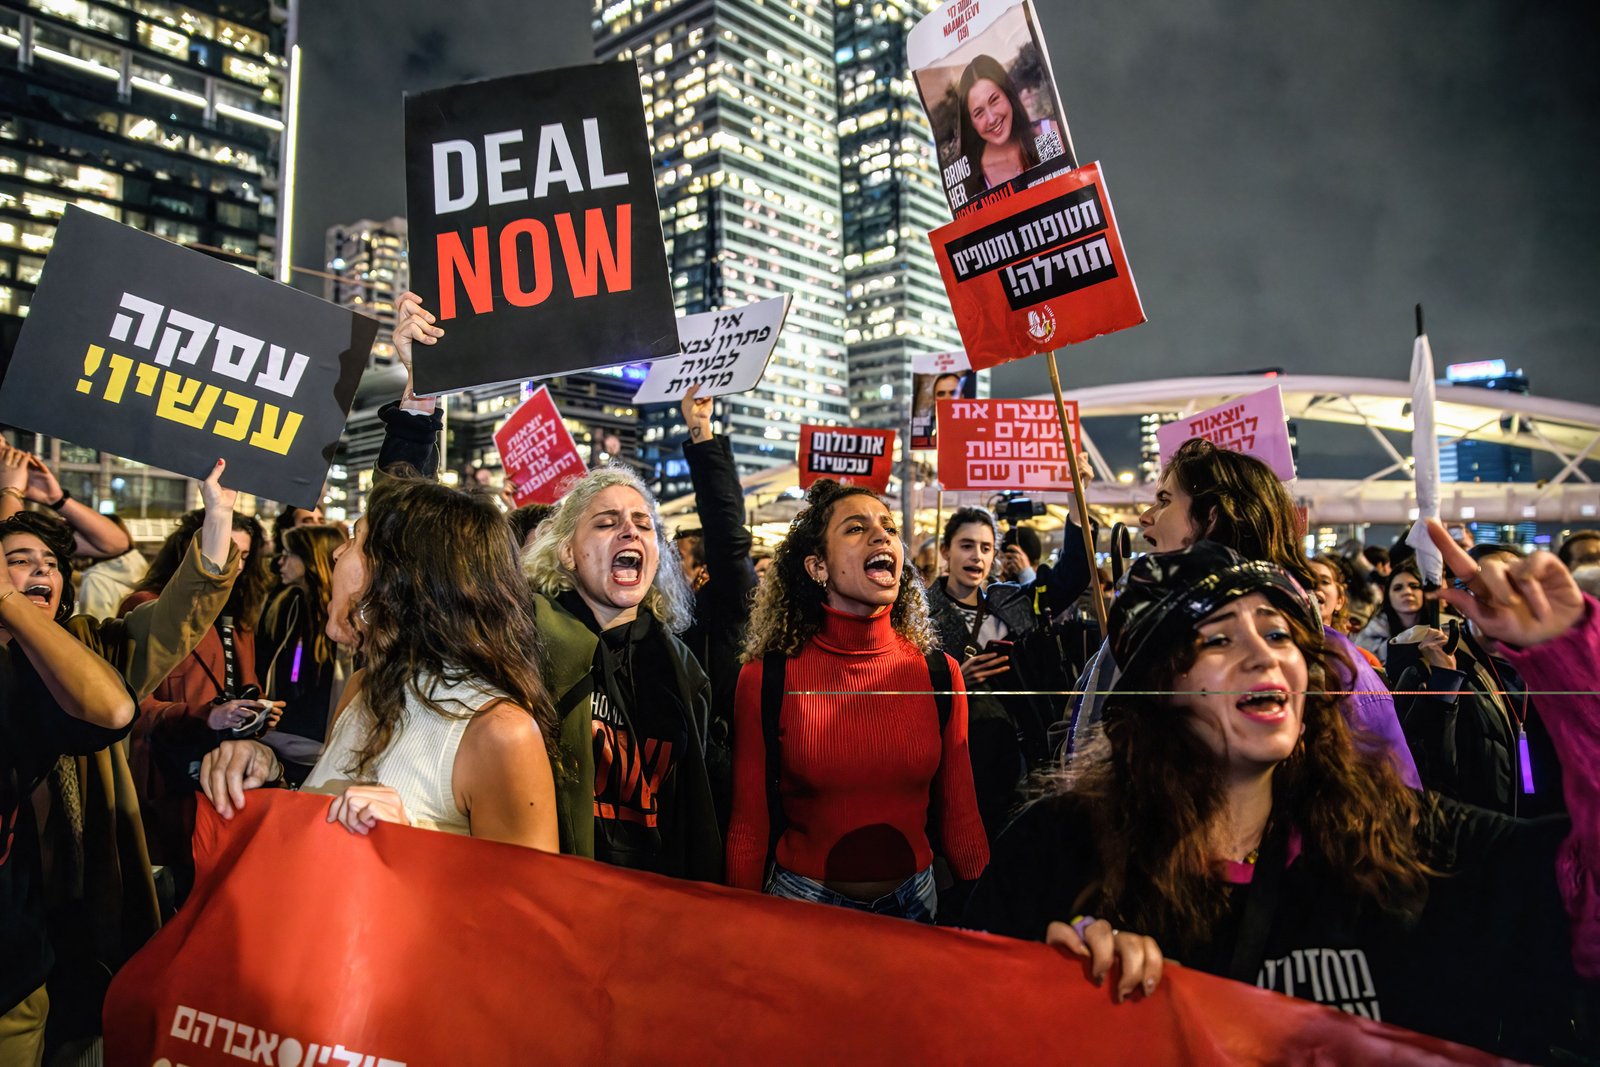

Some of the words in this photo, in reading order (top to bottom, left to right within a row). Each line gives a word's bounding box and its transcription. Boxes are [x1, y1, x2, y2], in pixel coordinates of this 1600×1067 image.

[943, 14, 965, 38] NAAMA
[965, 2, 980, 22] LEVY
[957, 24, 970, 43] (19)
[432, 117, 630, 216] DEAL
[943, 155, 972, 189] BRING
[948, 183, 968, 210] HER
[1018, 199, 1100, 252] חטופות
[436, 203, 632, 321] NOW
[953, 230, 1020, 276] וחטופים
[1005, 237, 1113, 298] תחילה!
[712, 312, 744, 336] אין
[715, 326, 771, 354] פתרון
[109, 292, 310, 398] עסקה
[679, 349, 740, 375] לבעיה
[681, 337, 716, 354] צבא
[76, 343, 304, 456] עכשיו!
[952, 403, 989, 419] את
[507, 414, 543, 449] יוצאות
[1190, 404, 1245, 436] יוצאות
[505, 419, 556, 466] לרחובות
[510, 433, 557, 471] להחזיר
[859, 436, 885, 455] את
[528, 454, 552, 476] את
[812, 453, 869, 474] עכשיו!
[969, 464, 1010, 481] שם
[1256, 948, 1377, 1001] מחזירי
[170, 1004, 280, 1067] אברהם
